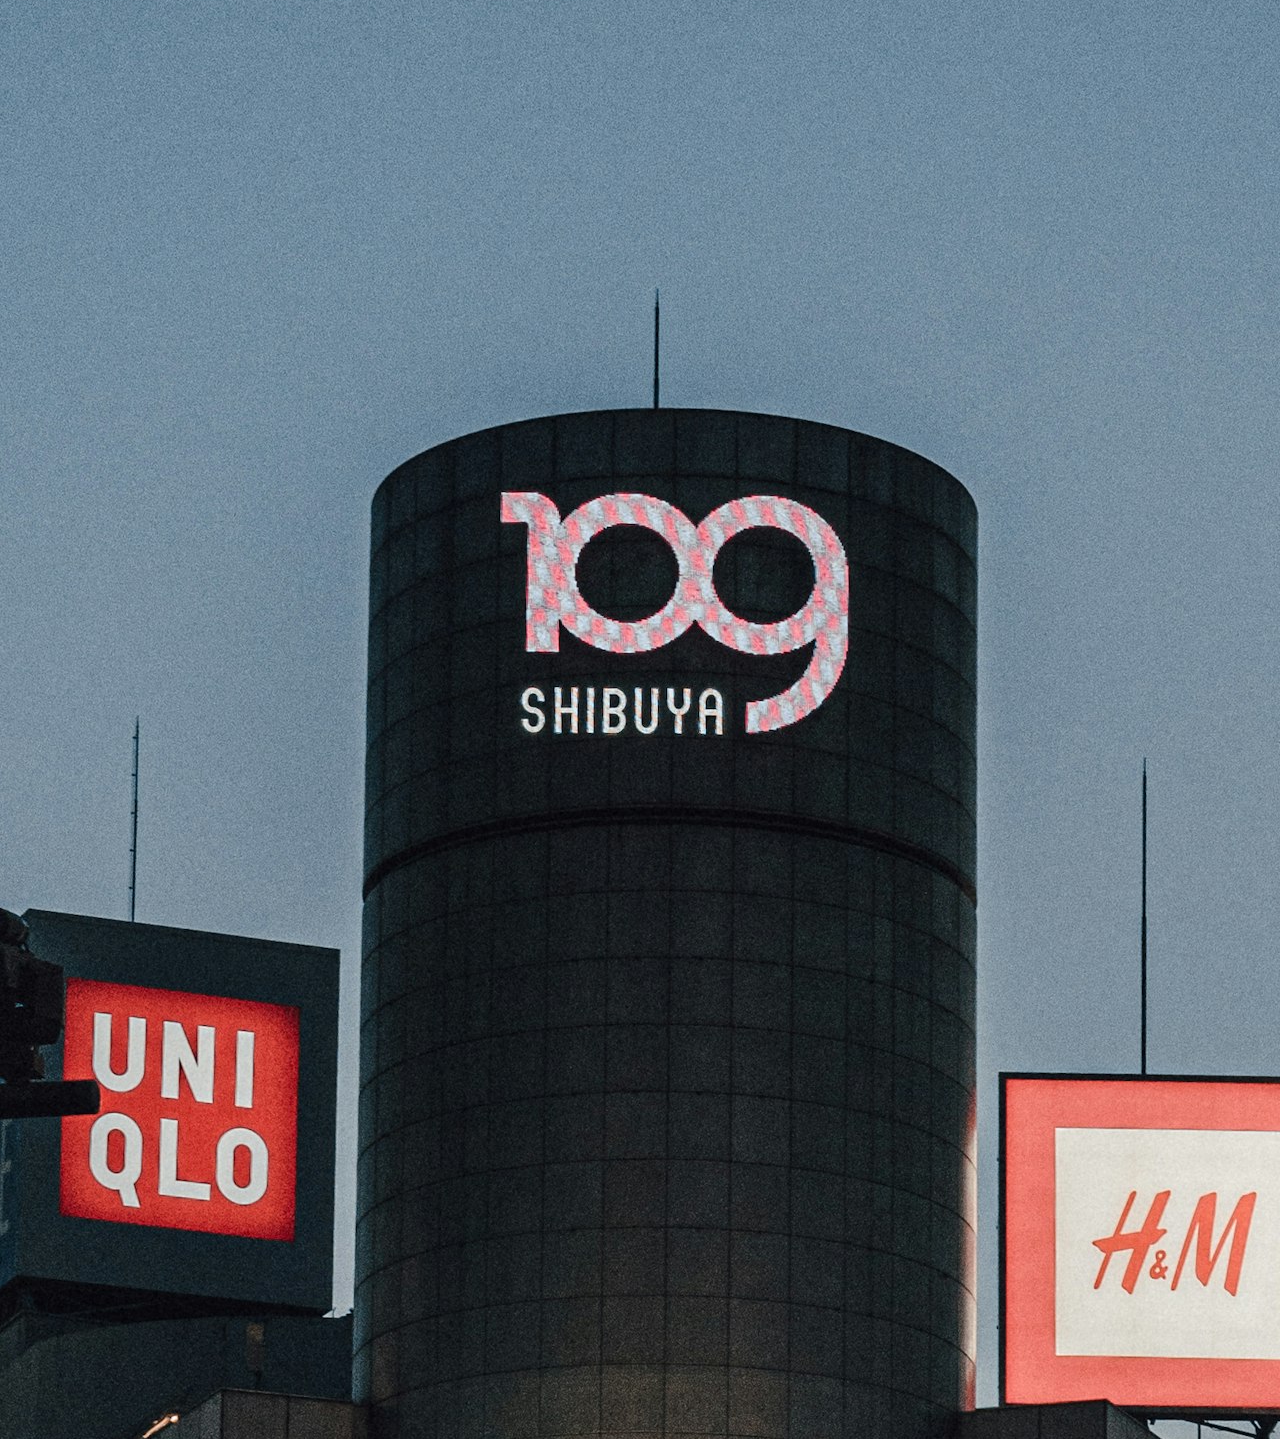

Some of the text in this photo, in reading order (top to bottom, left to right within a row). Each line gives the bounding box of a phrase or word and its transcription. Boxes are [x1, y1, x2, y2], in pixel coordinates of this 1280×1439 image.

[500, 490, 850, 735] 109
[520, 686, 726, 736] SHIBUYA
[91, 1010, 256, 1109] UNI
[88, 1111, 270, 1209] QLO
[1091, 1189, 1257, 1300] H&M
